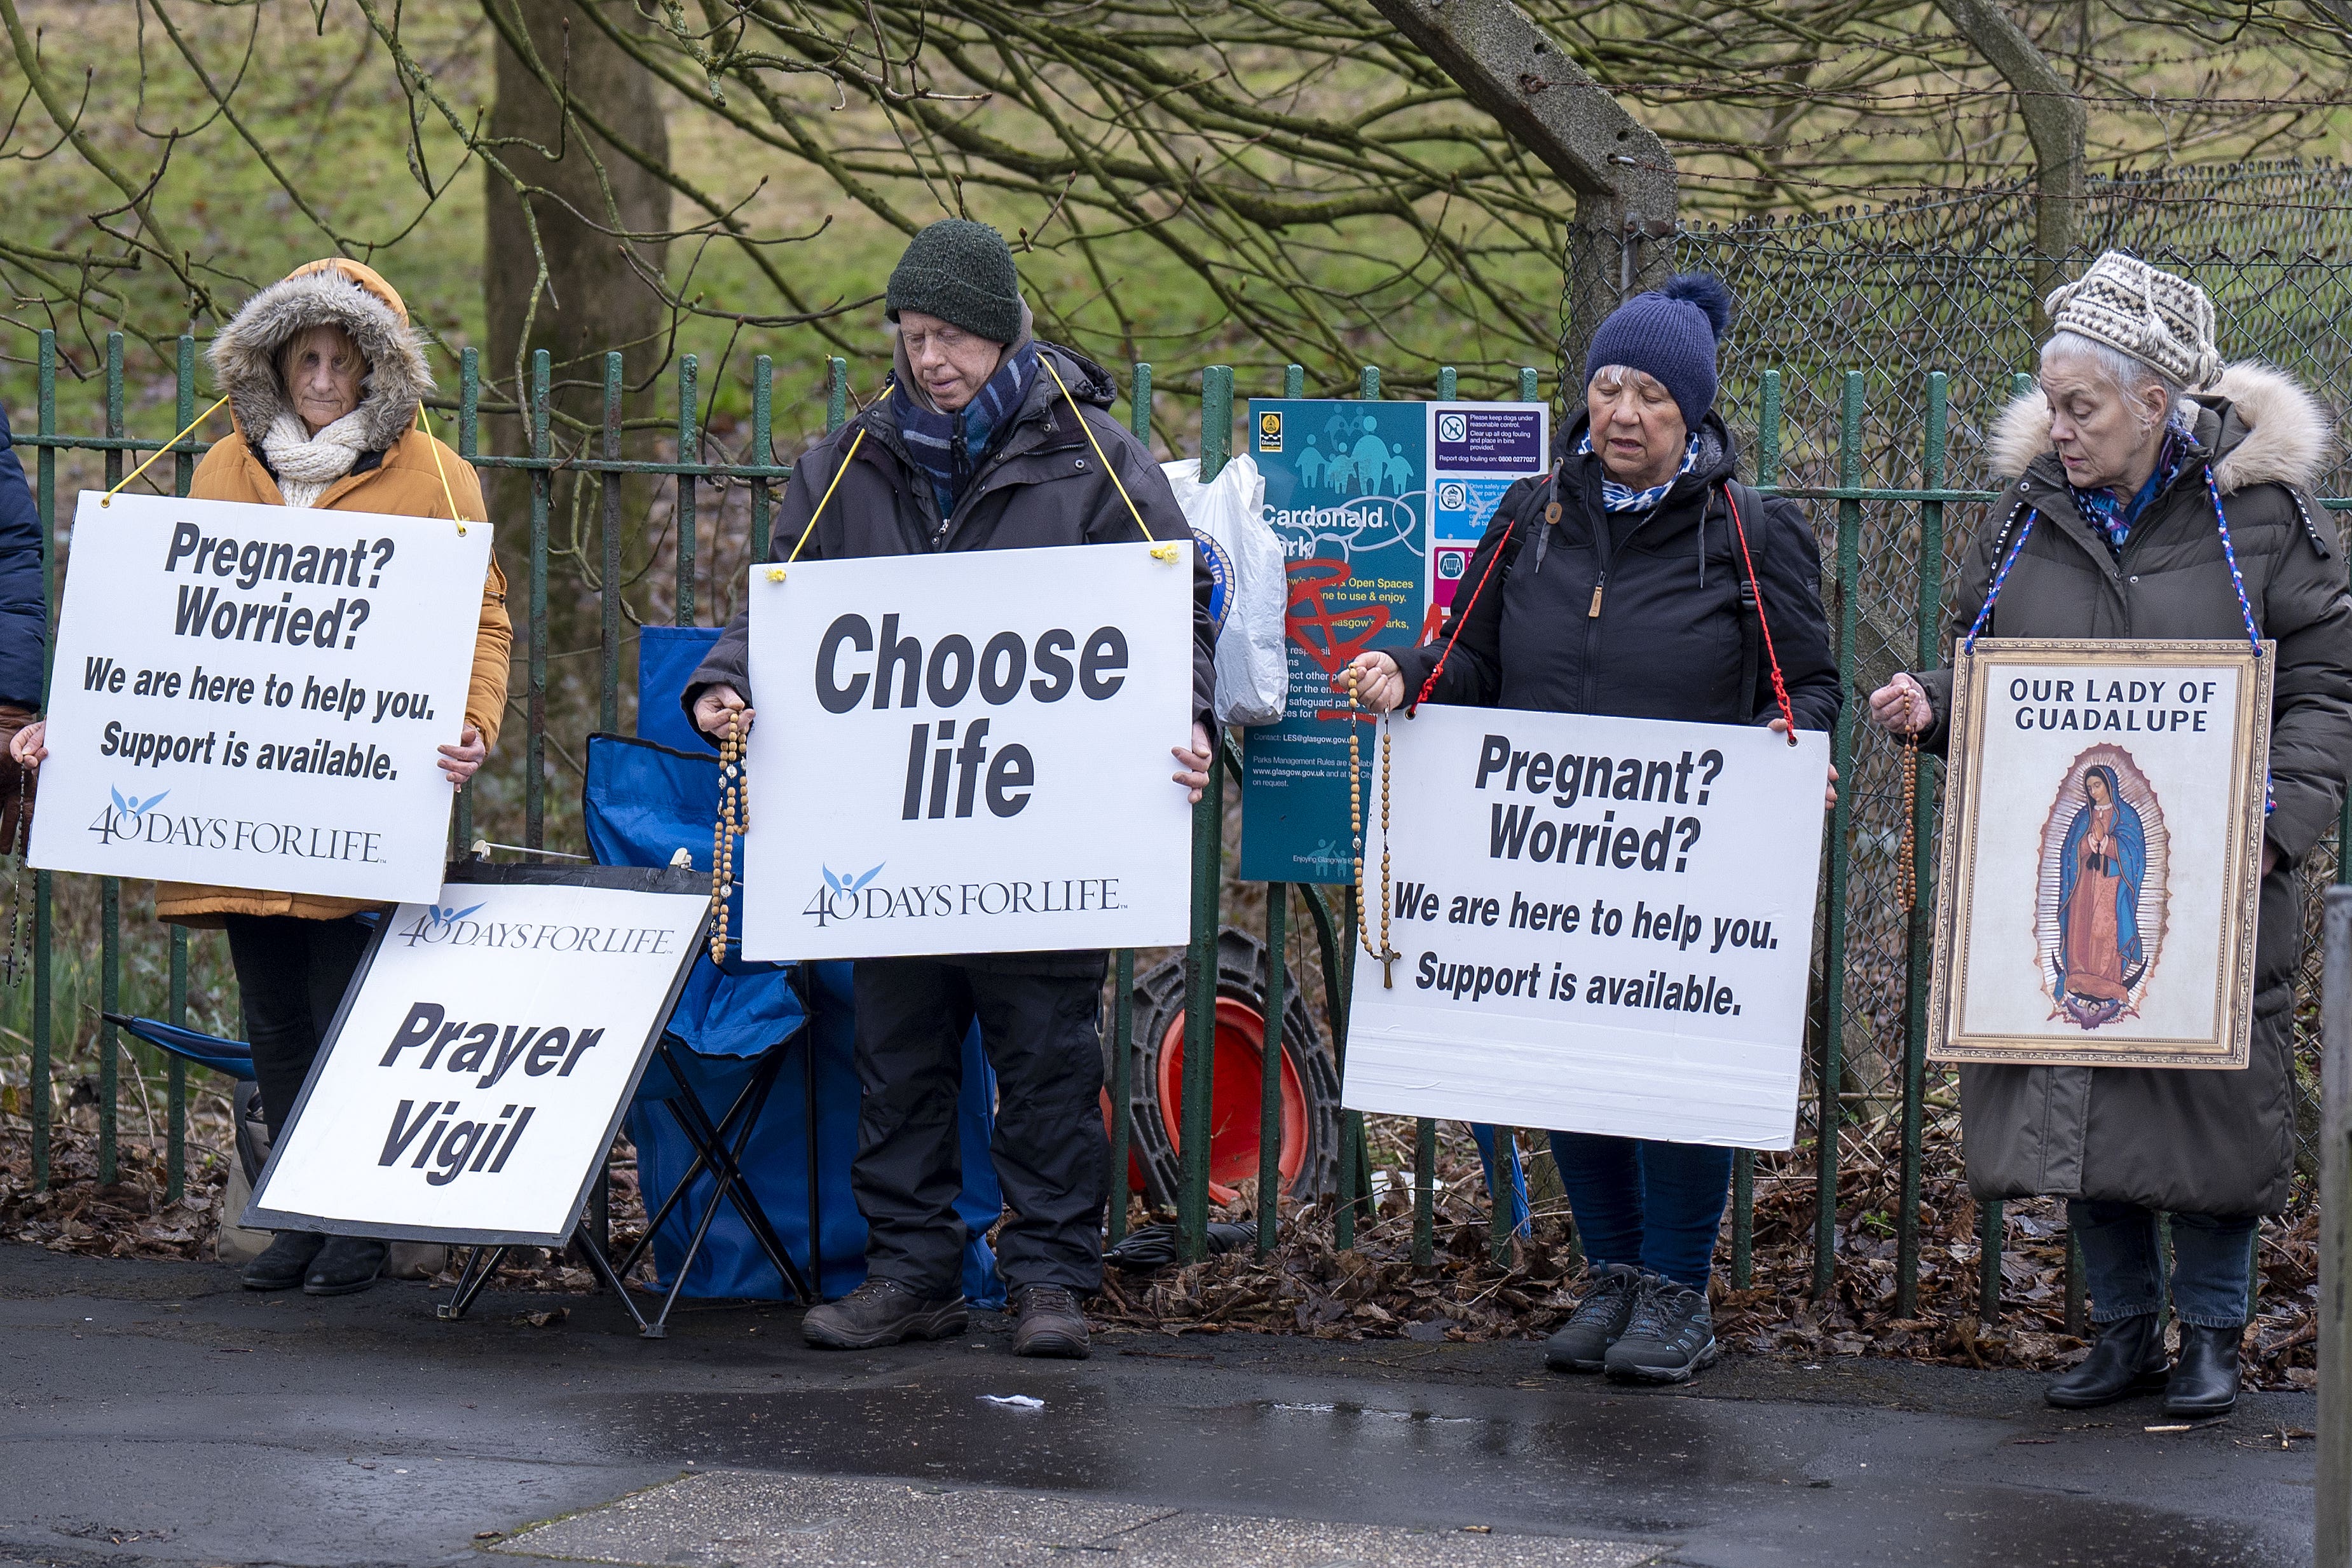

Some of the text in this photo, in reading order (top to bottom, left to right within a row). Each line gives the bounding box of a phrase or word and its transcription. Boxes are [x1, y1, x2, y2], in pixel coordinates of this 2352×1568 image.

[165, 522, 394, 589] Pregnant?
[1337, 592, 1346, 601] to
[1369, 592, 1376, 601] &
[1379, 593, 1406, 604] enjoy.
[1349, 578, 1374, 589] Open
[1378, 578, 1414, 590] Spaces
[175, 585, 369, 650] Worried?
[1386, 619, 1409, 630] arks,
[85, 657, 434, 723] We are here to help you.
[816, 613, 1128, 714] Choose
[2011, 679, 2215, 703] OUR LADY OF
[1289, 698, 1332, 707] safeguard
[1336, 700, 1360, 709] pars
[2016, 707, 2206, 731] GUADALUPE
[101, 721, 397, 780] Support is available.
[902, 718, 1034, 820] life
[1252, 768, 1324, 777] www.glasgow.gov.uk
[1273, 756, 1315, 766] Management
[1475, 735, 1723, 808] Pregnant?
[88, 804, 142, 845] 40
[144, 814, 228, 849] DAYS
[232, 821, 306, 857] FOR
[1491, 803, 1700, 872] Worried?
[1293, 855, 1316, 863] Enjoying
[1318, 856, 1347, 864] Glasgow's
[397, 913, 451, 948] 40
[451, 920, 533, 948] DAYS
[532, 925, 600, 952] FOR
[802, 884, 859, 927] 40
[863, 885, 952, 919] DAYS
[959, 882, 1040, 915] FOR
[1395, 882, 1777, 953] We are here to help you.
[1416, 951, 1740, 1015] Support is available.
[378, 1002, 605, 1089] Prayer
[378, 1100, 536, 1186] Vigil
